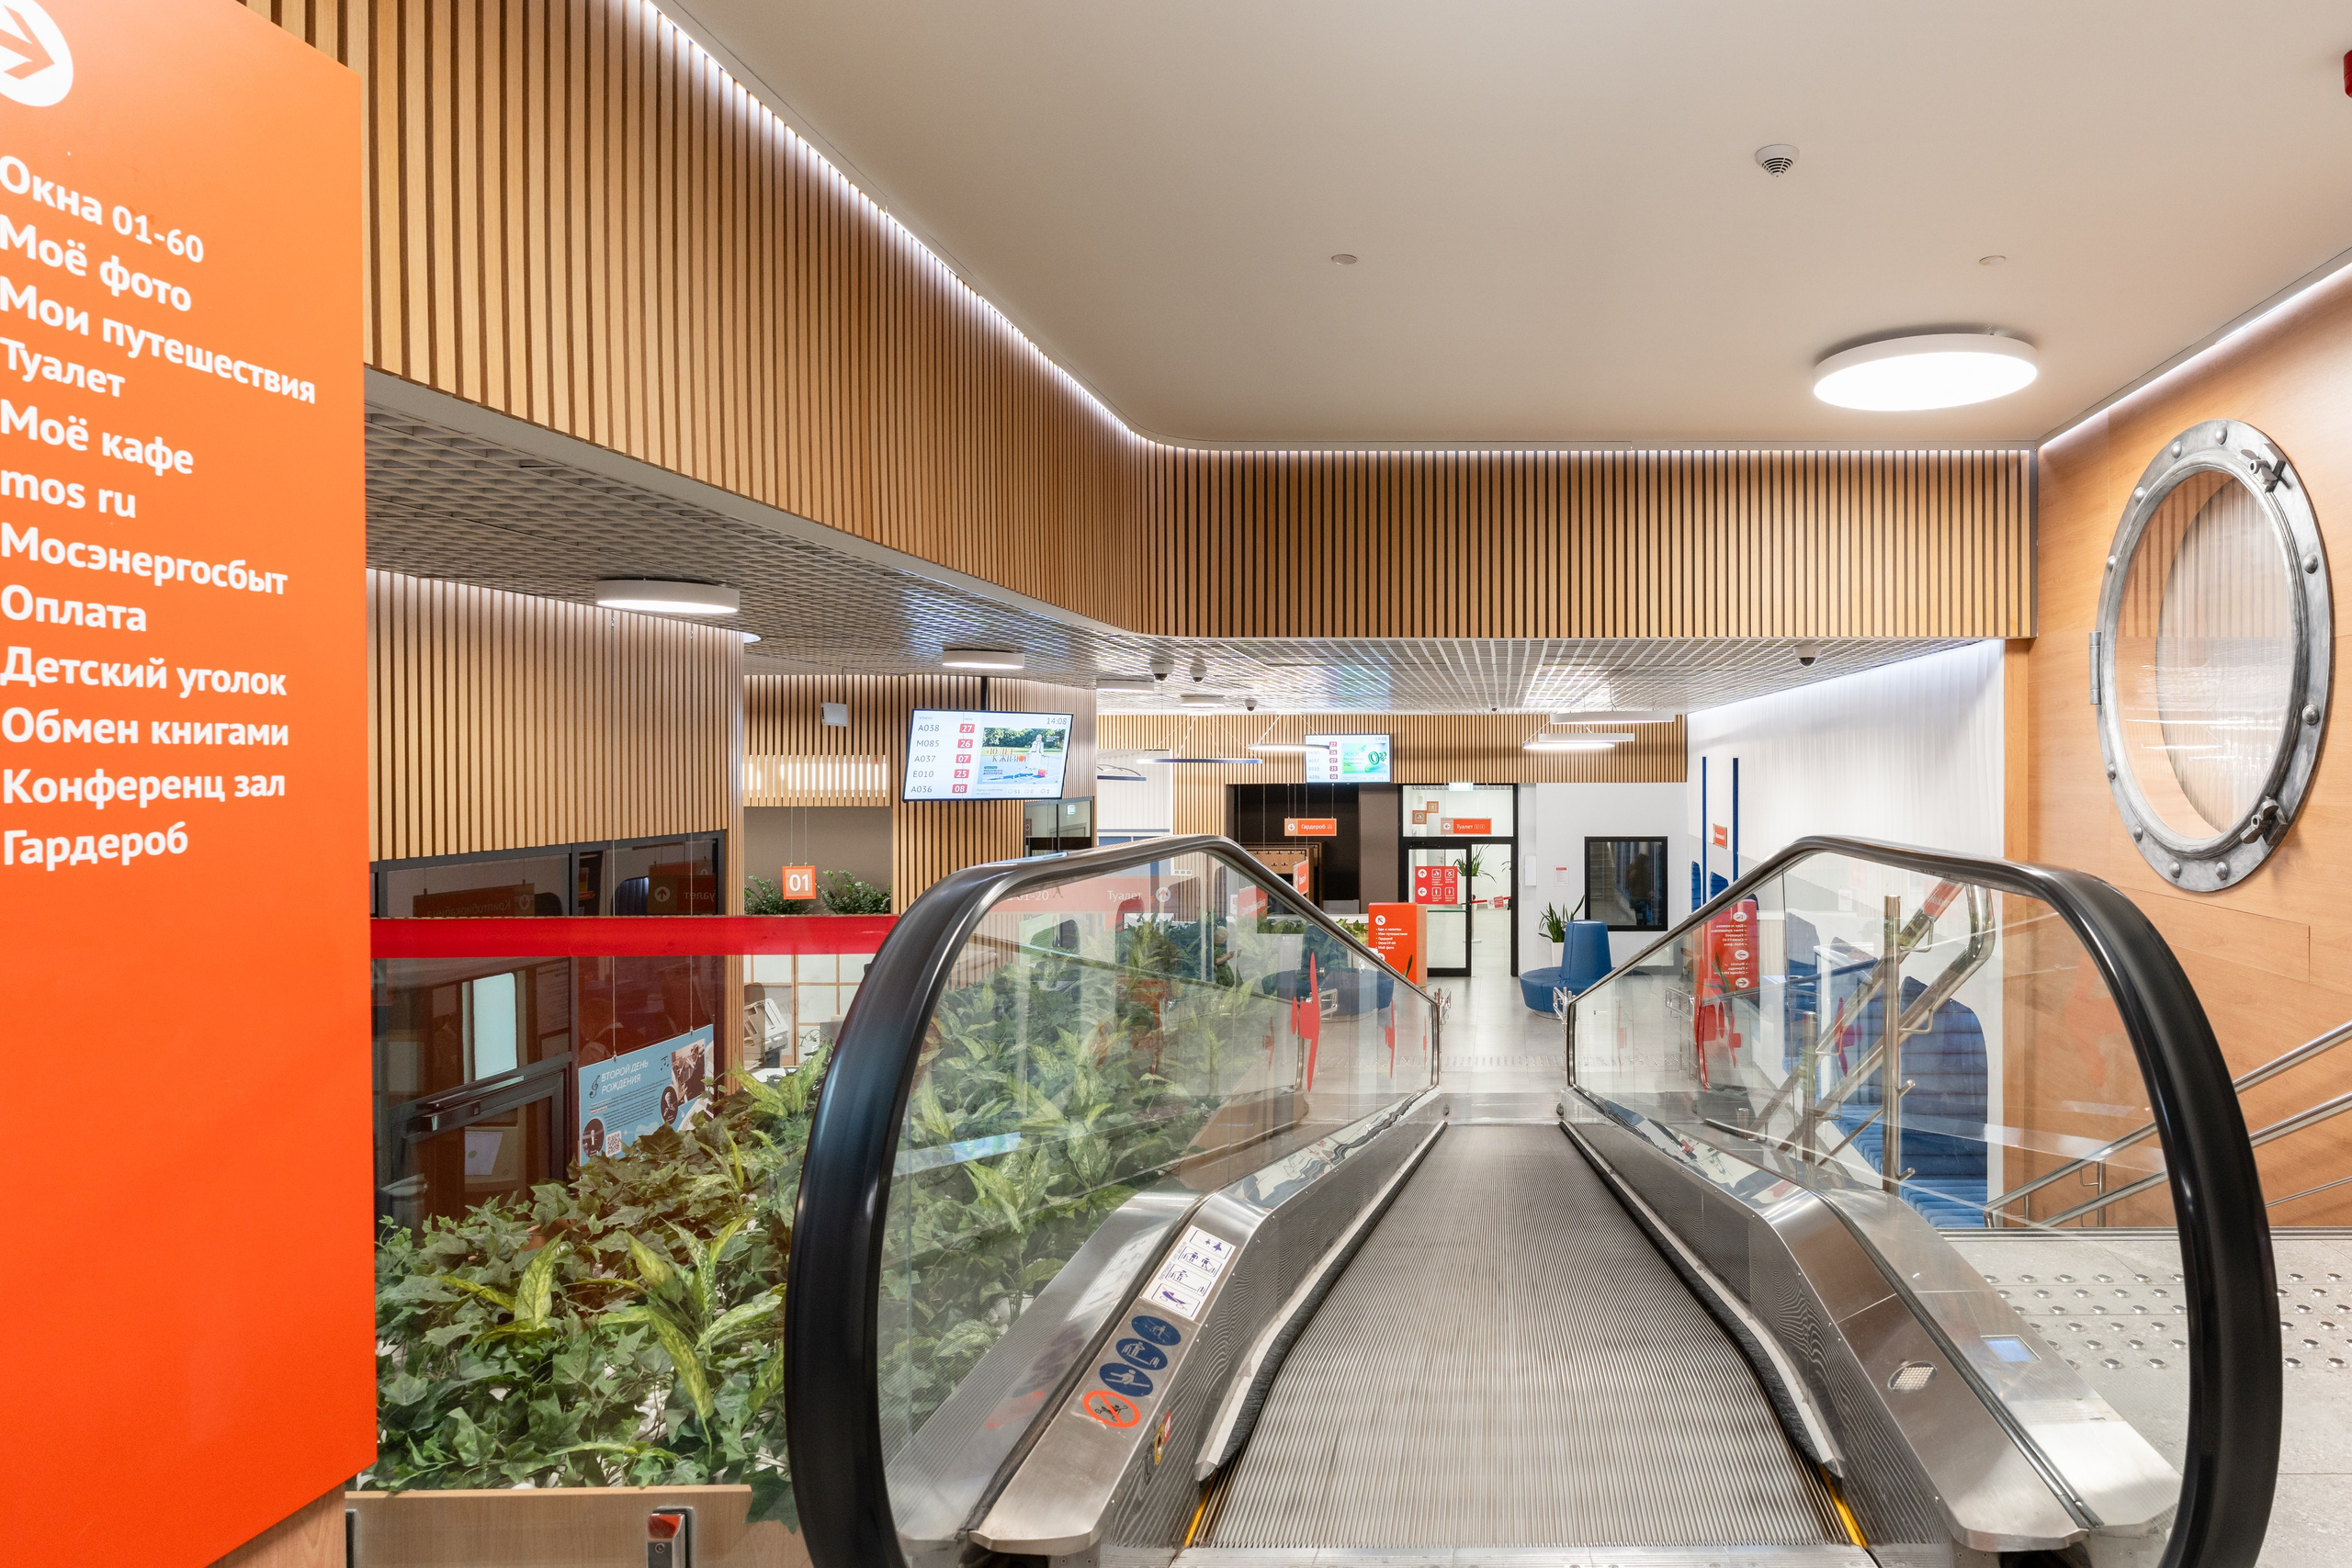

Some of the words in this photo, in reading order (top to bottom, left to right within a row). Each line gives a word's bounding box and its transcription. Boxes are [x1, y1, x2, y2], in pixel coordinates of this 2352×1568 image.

[0, 156, 102, 225] Окна
[113, 206, 204, 263] 01-60
[0, 214, 87, 276] Моё
[100, 255, 191, 311] фото
[0, 276, 88, 335] Мои
[103, 319, 315, 404] путешествия
[0, 337, 125, 397] Туалет
[0, 400, 88, 450] Моё
[102, 433, 194, 476] кафе
[0, 470, 85, 508] mos
[98, 490, 136, 518] ru
[1, 523, 288, 595] Мосэнергосбыт
[2, 585, 147, 631] Оплата
[0, 647, 166, 689] Детский
[175, 667, 287, 698] уголок
[3, 707, 139, 744] Обмен
[152, 721, 288, 746] книгами
[4, 769, 225, 809] Конференц
[235, 774, 285, 797] зал
[956, 770, 967, 778] 25
[4, 821, 188, 871] Гардероб
[789, 874, 808, 891] 01
[1107, 890, 1142, 902] Туалет
[602, 1064, 630, 1082] ВТОРОЙ
[630, 1059, 649, 1074] ДЕНЬ
[602, 1073, 641, 1094] РОЖДЕНИЯ
